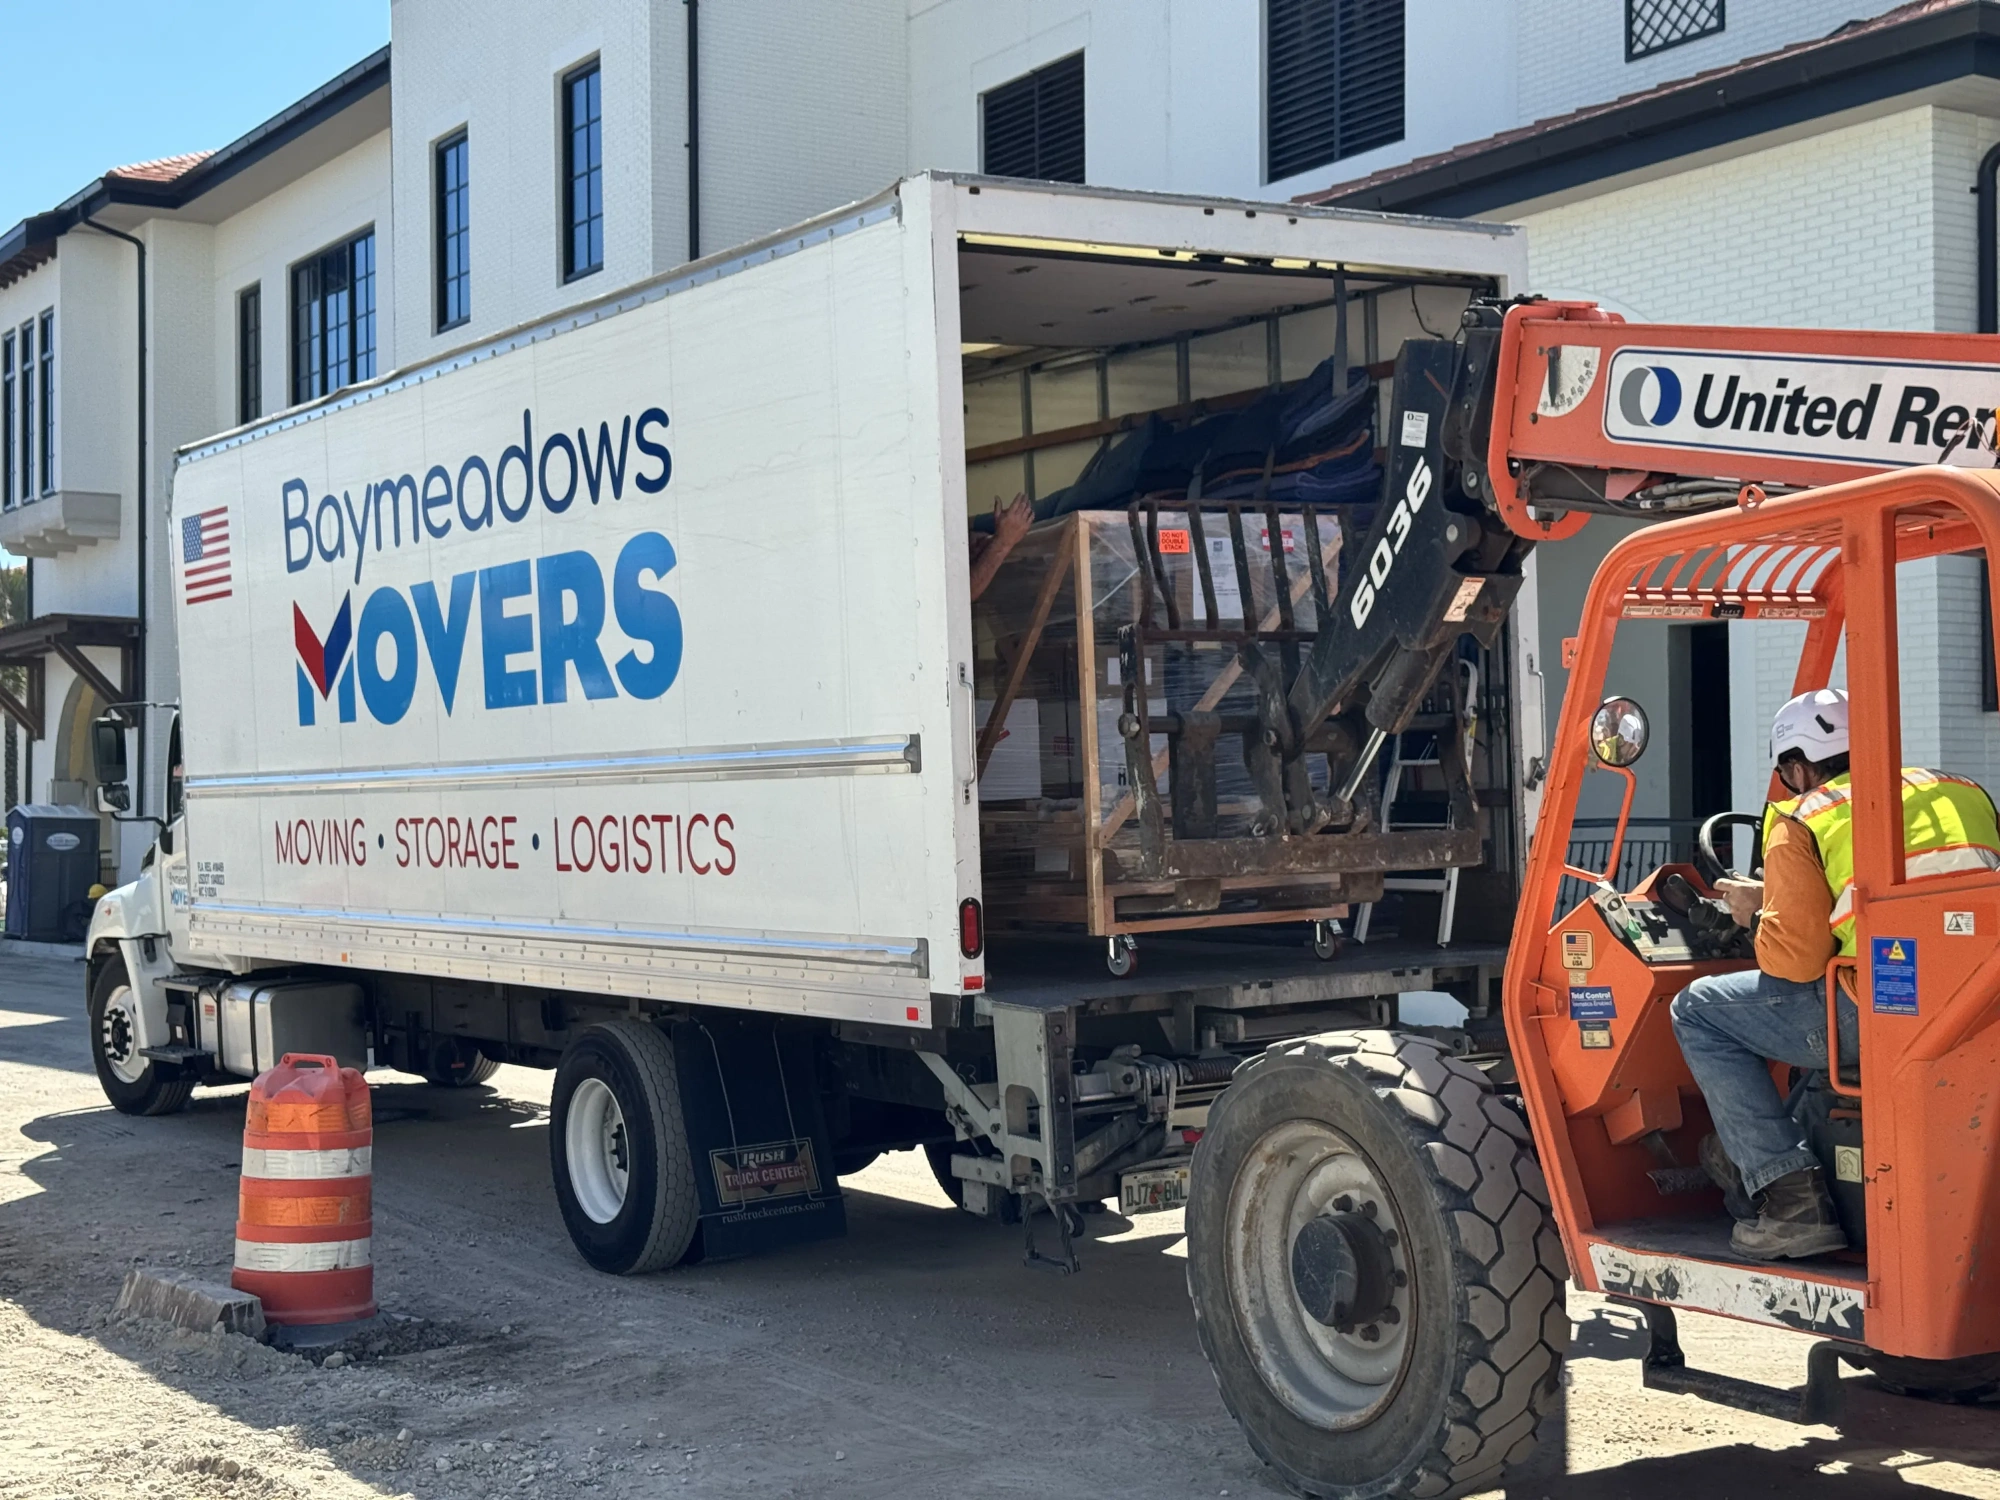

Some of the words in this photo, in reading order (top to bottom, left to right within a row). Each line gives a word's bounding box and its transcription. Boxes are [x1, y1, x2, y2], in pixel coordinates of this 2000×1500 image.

[1693, 373, 1882, 441] United
[1888, 385, 1997, 450] Ren
[283, 408, 672, 585] Baymeadows
[1350, 456, 1432, 629] 6036
[293, 531, 683, 727] MOVERS
[275, 818, 366, 866] MOVING
[396, 816, 519, 868] STORAGE
[555, 813, 736, 876] LOGISTICS
[725, 1170, 760, 1187] TRUCK
[761, 1164, 808, 1182] CENTERS
[743, 1149, 785, 1168] RUSH
[722, 1200, 825, 1224] rushtruckcenters.com
[1601, 1257, 1858, 1329] SKAK
